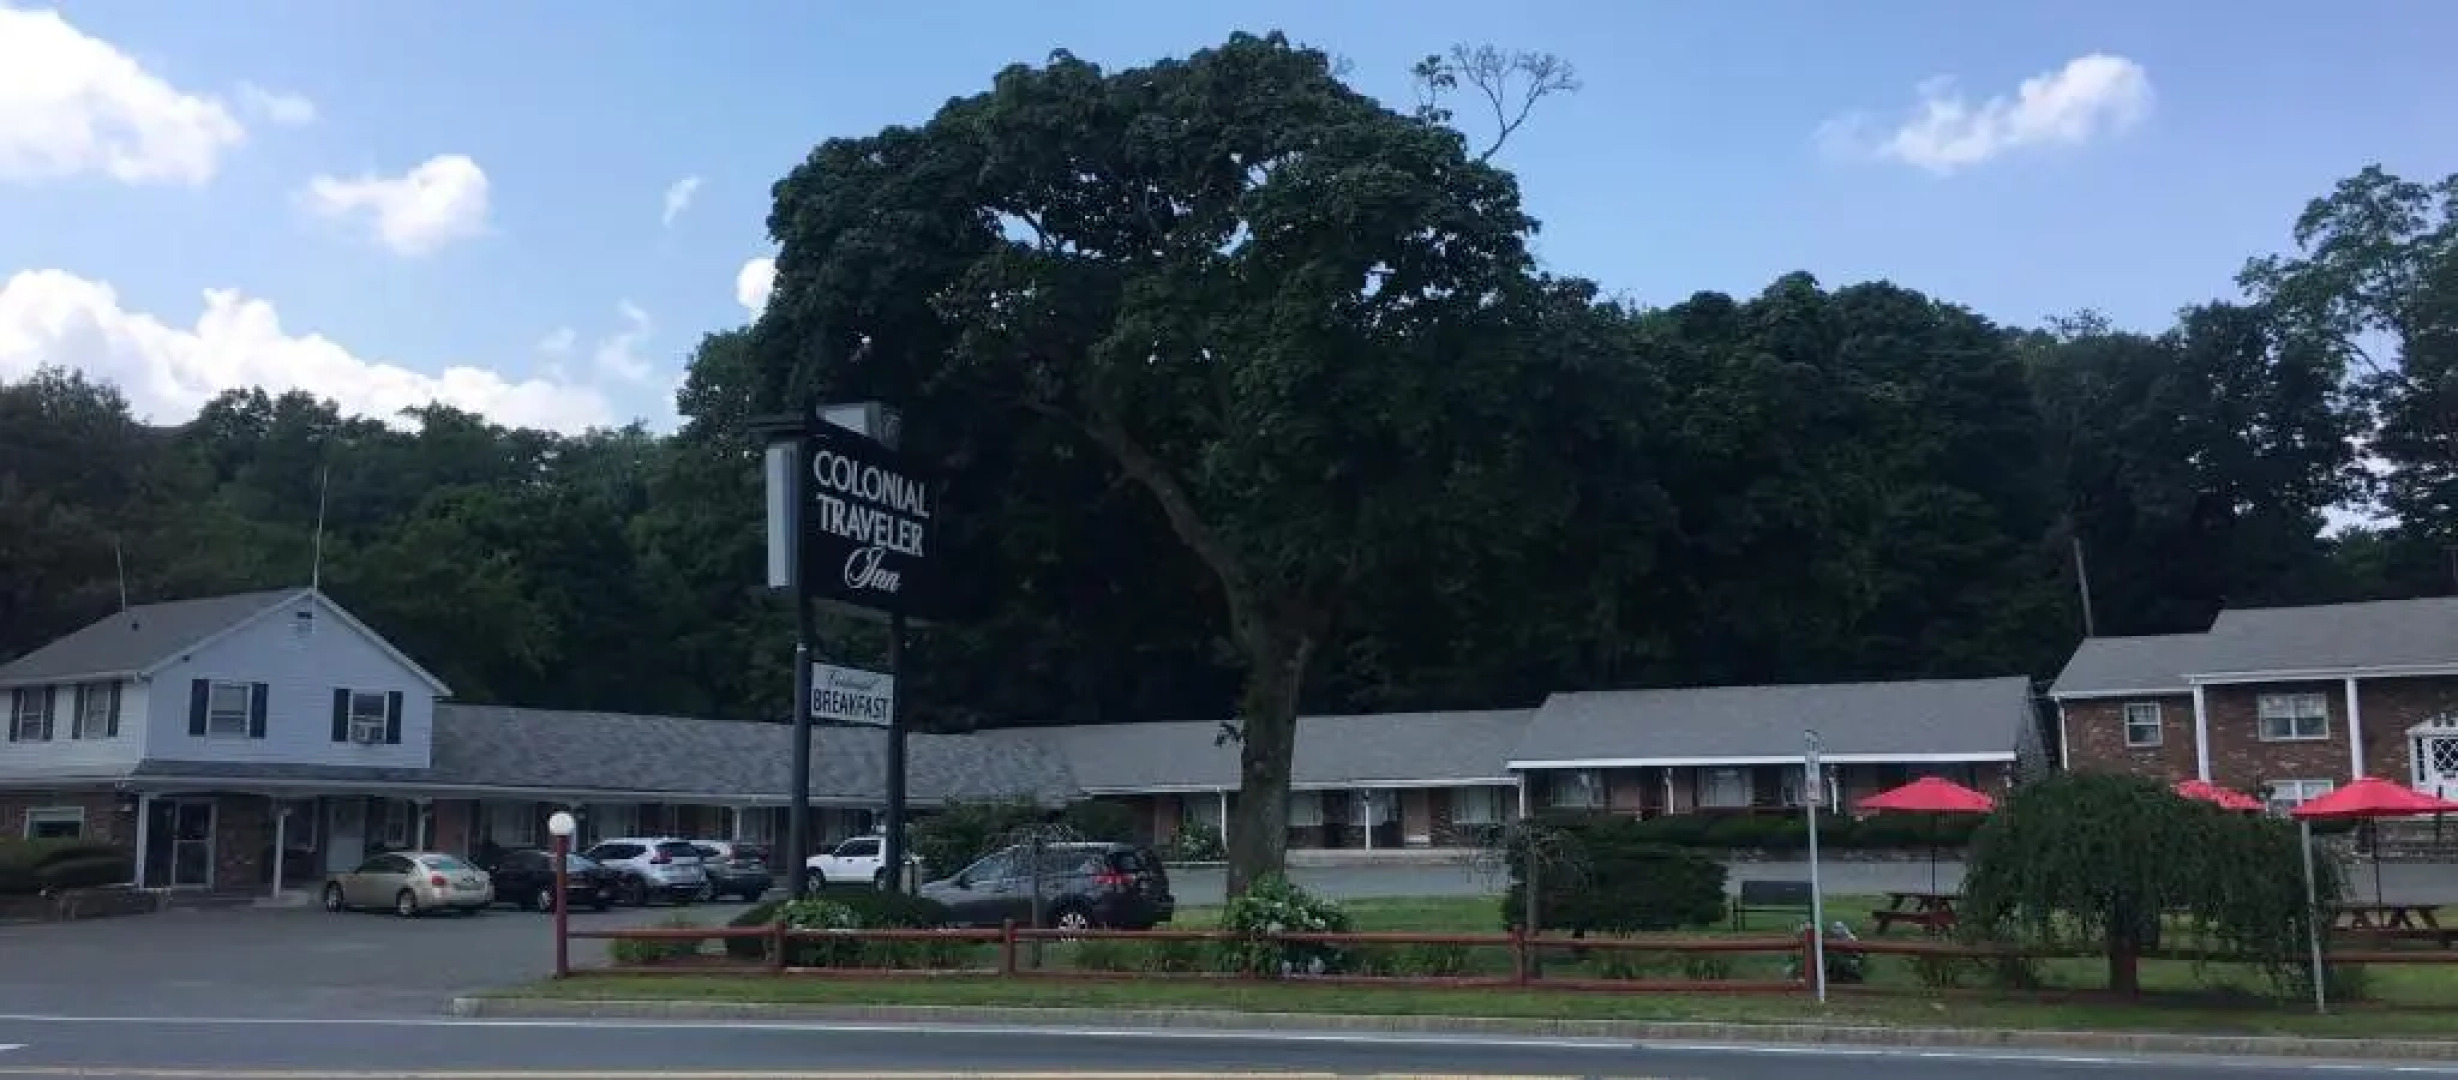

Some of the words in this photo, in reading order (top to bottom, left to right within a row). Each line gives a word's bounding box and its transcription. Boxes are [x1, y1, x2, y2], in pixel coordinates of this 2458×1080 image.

[814, 450, 930, 519] COLONIAL
[816, 492, 924, 558] TRAVELER
[845, 547, 901, 593] Inn
[813, 689, 889, 720] BREAKFAST
